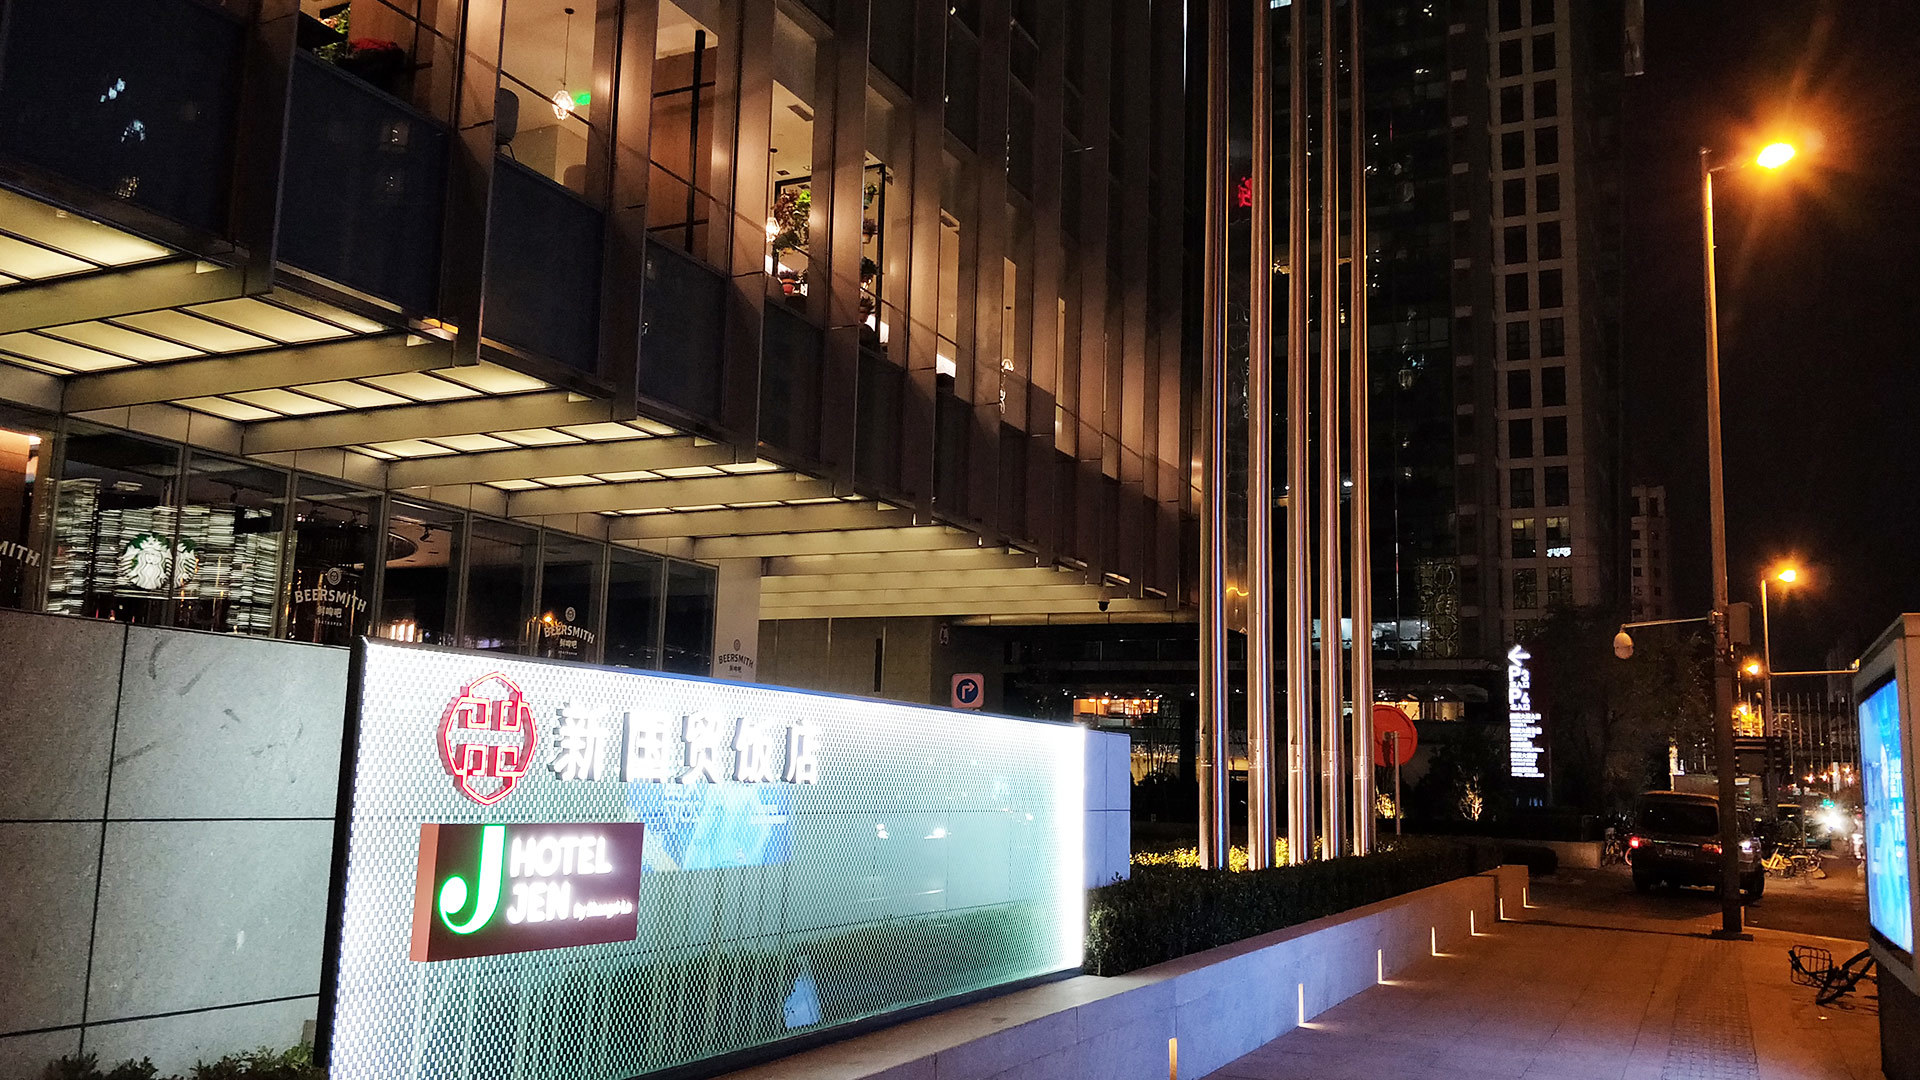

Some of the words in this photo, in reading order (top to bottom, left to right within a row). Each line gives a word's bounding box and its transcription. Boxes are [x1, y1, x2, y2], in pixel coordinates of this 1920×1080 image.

[294, 588, 367, 612] BEERSMITH
[543, 624, 595, 644] BEERSMITH
[718, 653, 754, 669] BEERSMITH
[1509, 665, 1530, 682] P3
[548, 698, 822, 784] 新国贸饭店
[509, 836, 613, 878] HOTEL
[506, 880, 571, 924] JEN
